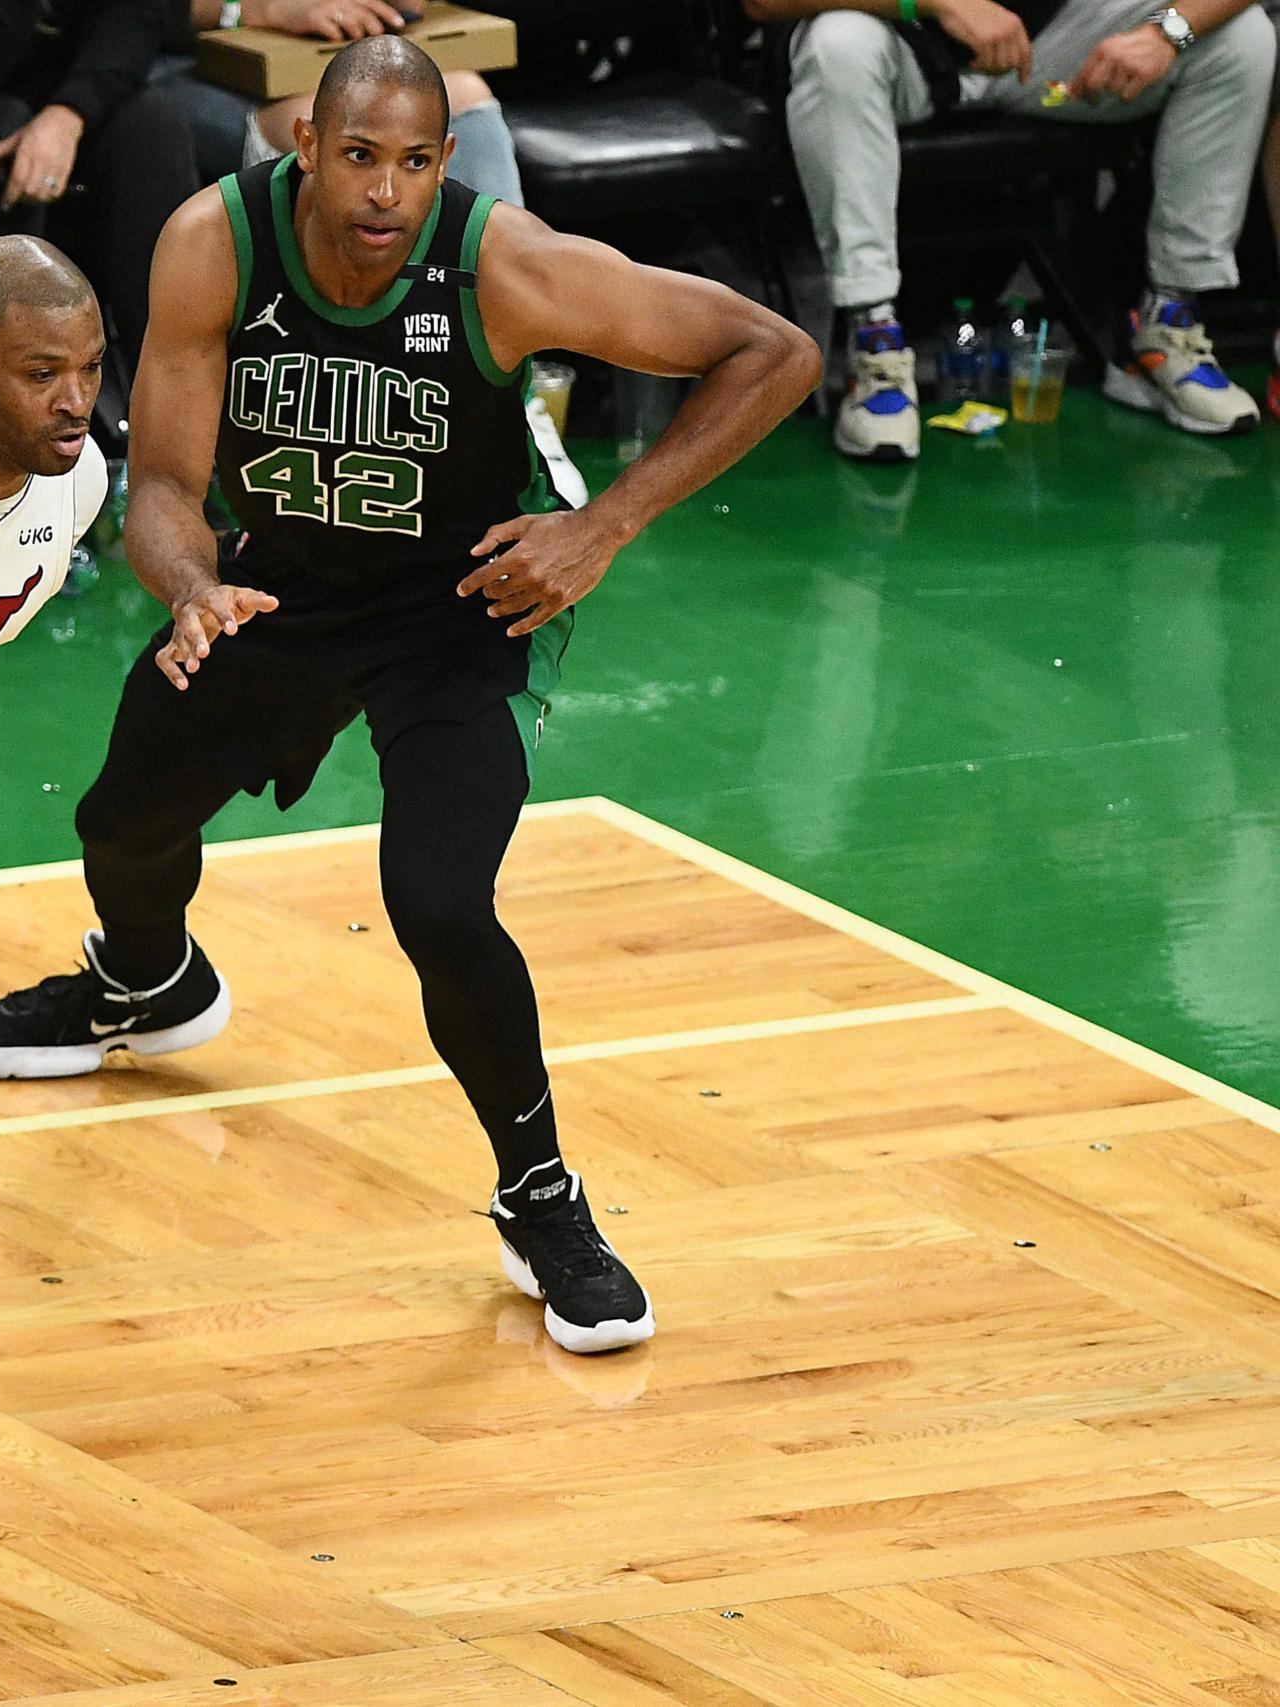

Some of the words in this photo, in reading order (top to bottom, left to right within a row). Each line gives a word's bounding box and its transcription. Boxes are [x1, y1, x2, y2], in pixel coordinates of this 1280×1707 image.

[427, 267, 445, 283] 24
[404, 313, 451, 336] VISTA
[404, 336, 451, 353] PRINT
[229, 353, 449, 453] CELTICS
[240, 446, 423, 538] 42
